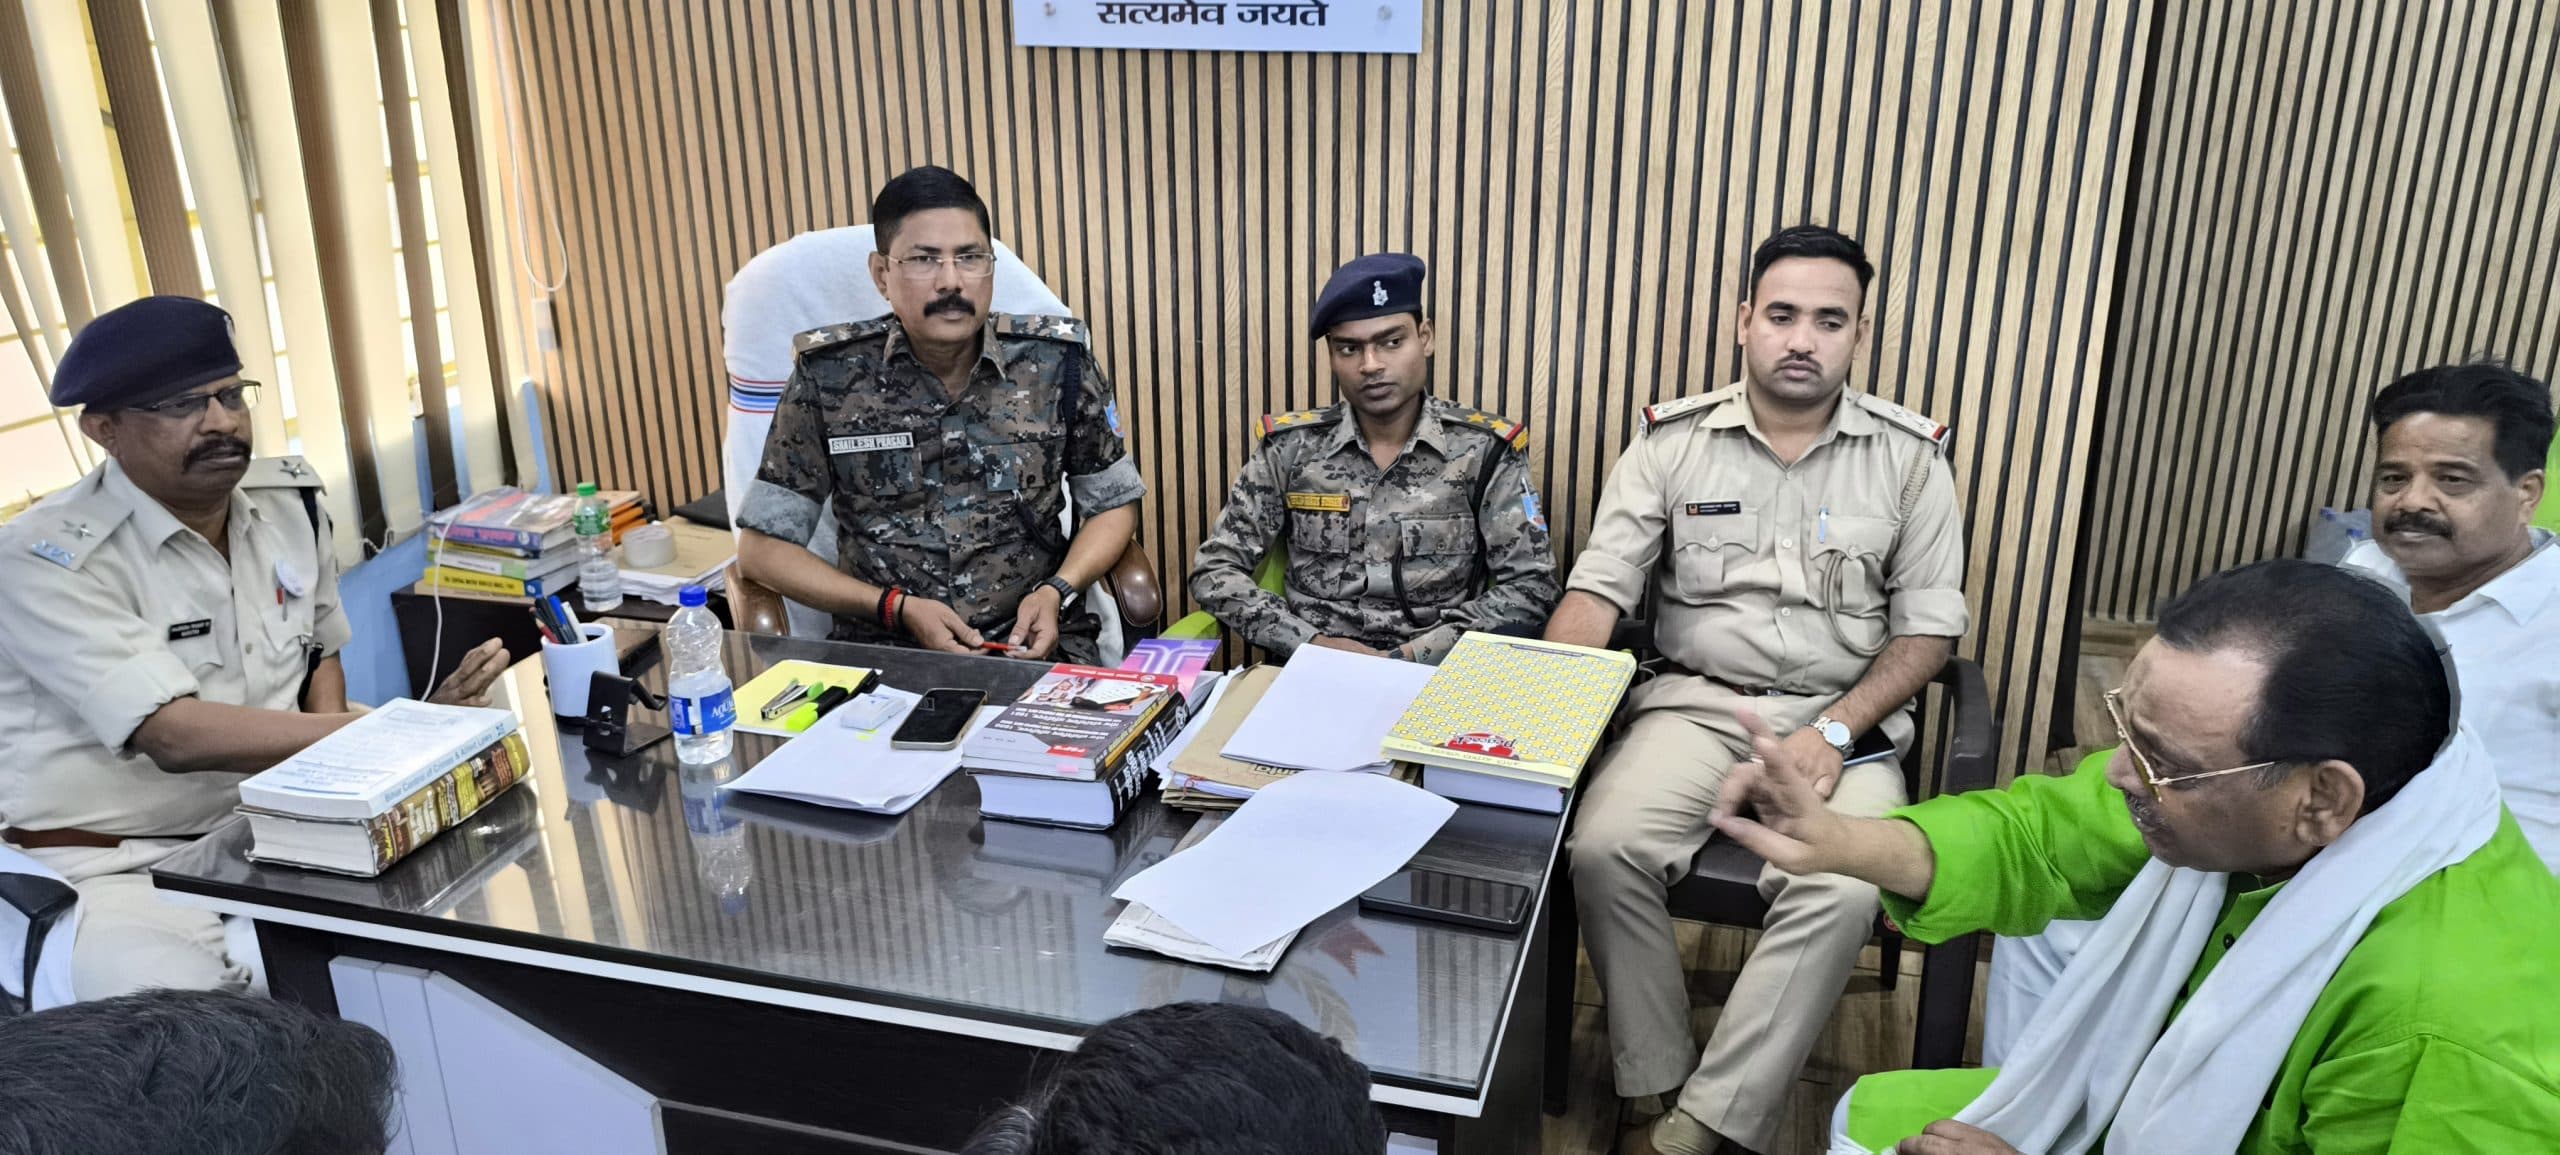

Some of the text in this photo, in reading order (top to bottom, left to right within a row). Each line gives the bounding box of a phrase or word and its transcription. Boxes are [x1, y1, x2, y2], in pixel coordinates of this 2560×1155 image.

[1096, 0, 1329, 26] सत्यमेव जयते
[832, 434, 907, 451] SHAILESH PRASAD
